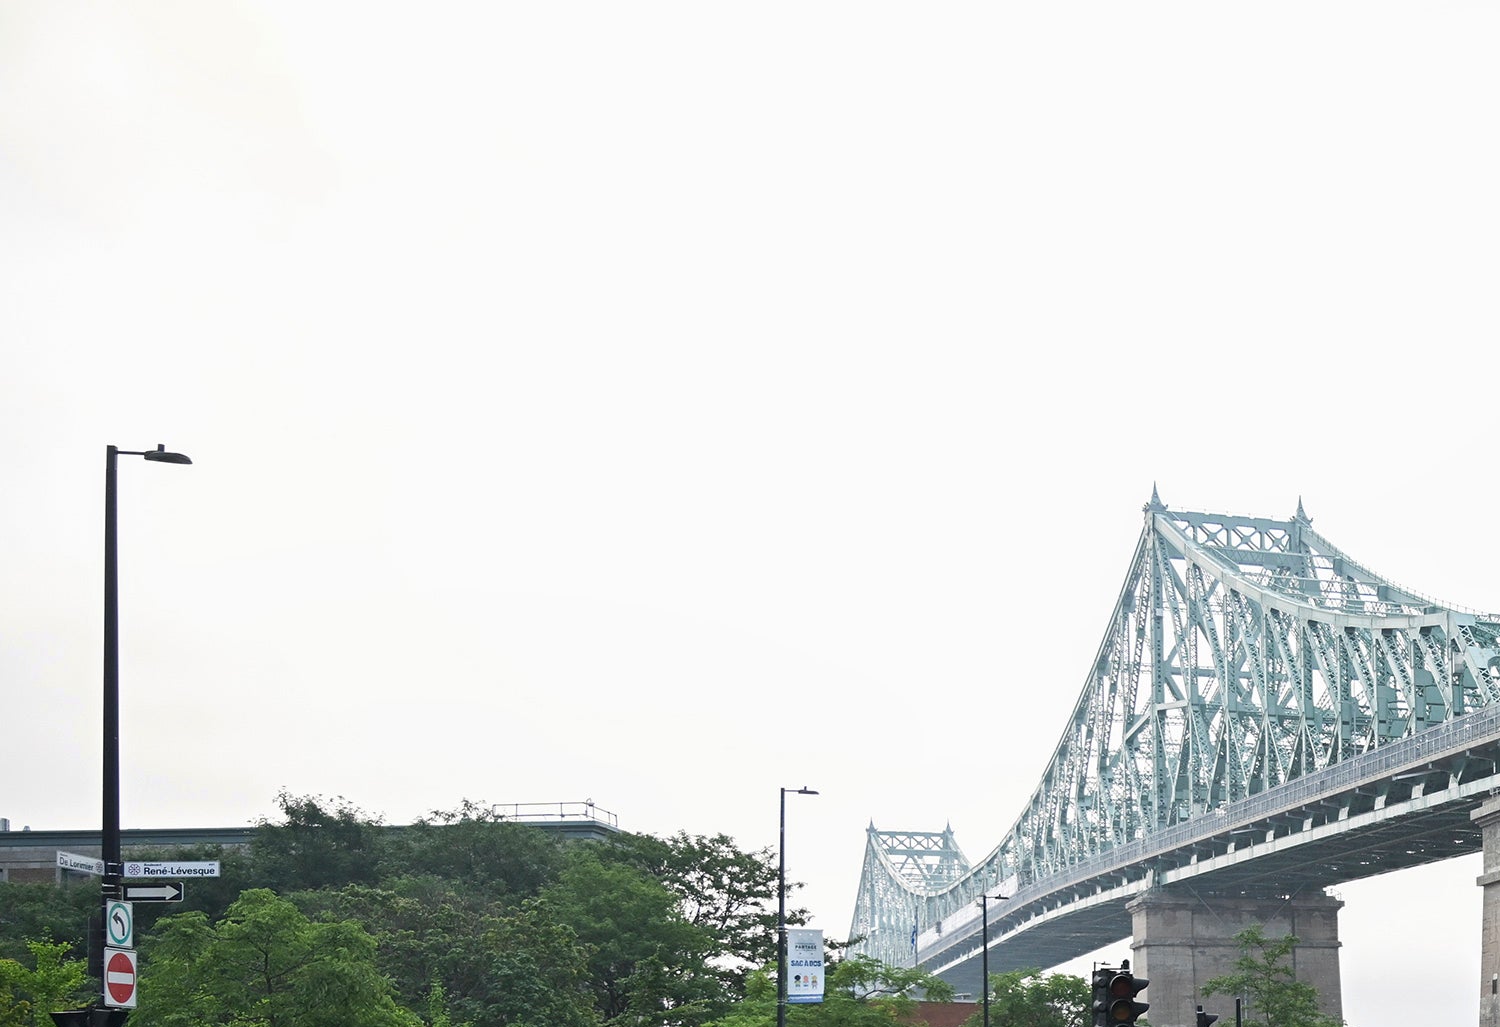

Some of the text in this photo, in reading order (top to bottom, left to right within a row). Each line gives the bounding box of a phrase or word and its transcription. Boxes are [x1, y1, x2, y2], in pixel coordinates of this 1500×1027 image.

[59, 856, 94, 871] De Lorimier
[143, 866, 215, 876] René-Lévesque
